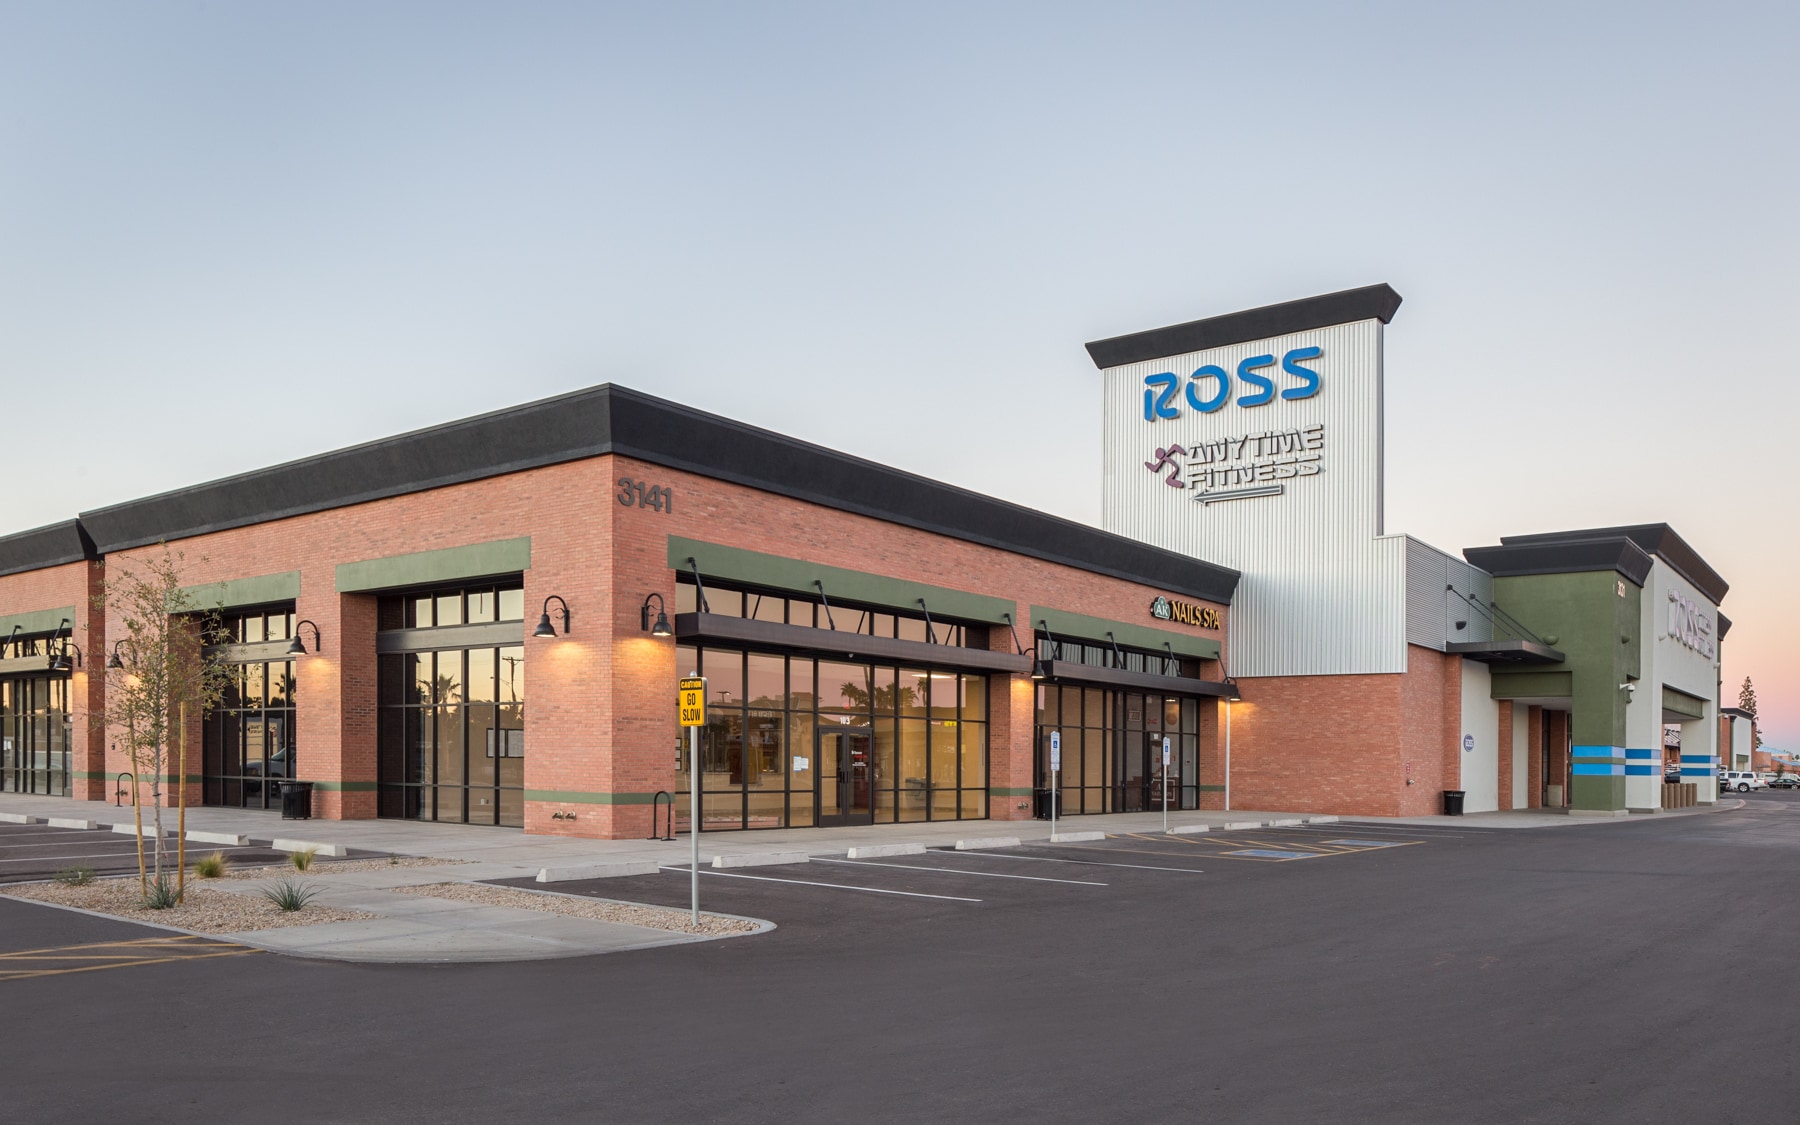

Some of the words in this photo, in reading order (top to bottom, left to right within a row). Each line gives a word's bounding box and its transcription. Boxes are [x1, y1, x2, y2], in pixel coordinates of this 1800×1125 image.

[1144, 346, 1323, 422] ROSS
[1187, 424, 1324, 466] ANYTIME
[1187, 454, 1321, 489] FITNESS
[617, 477, 672, 514] 3141
[1155, 604, 1169, 616] AK
[1171, 600, 1202, 626] NAILS
[1203, 607, 1221, 630] SPA
[683, 709, 701, 721] SLOW
[687, 693, 696, 705] GO
